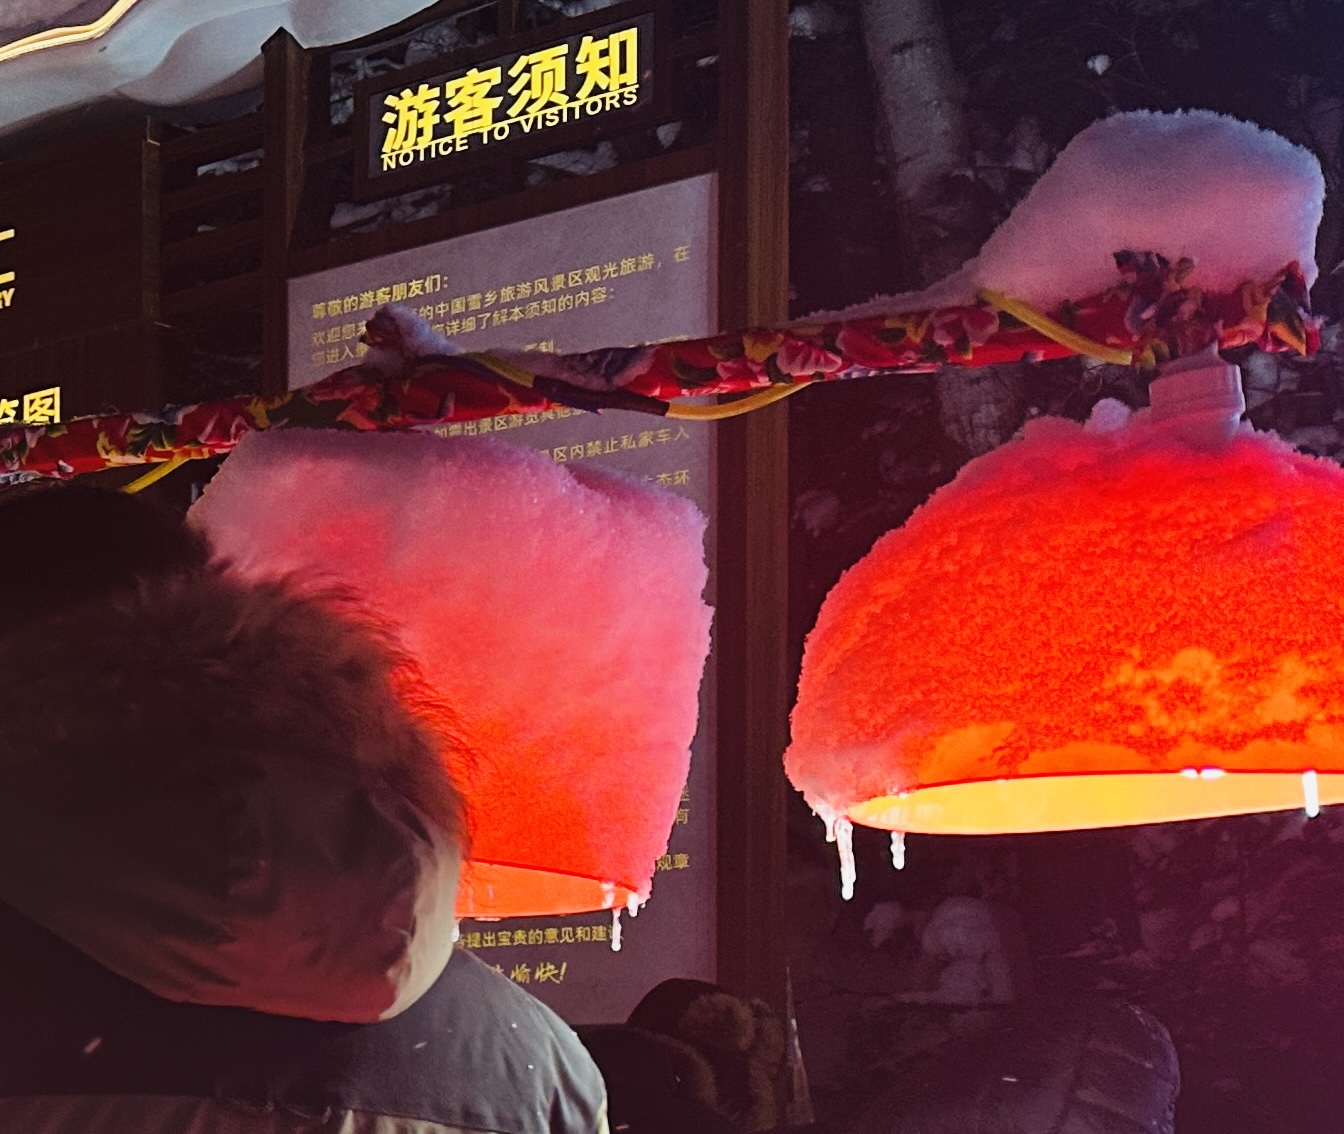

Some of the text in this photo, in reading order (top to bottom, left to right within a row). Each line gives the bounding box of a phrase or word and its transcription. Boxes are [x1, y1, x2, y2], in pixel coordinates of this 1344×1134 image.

[381, 27, 639, 154] 游客须知
[382, 86, 639, 171] NOTICE TO VISITORS
[540, 424, 690, 463] 区内禁止私家车入
[460, 925, 624, 949] 提出宝贵的意见和建
